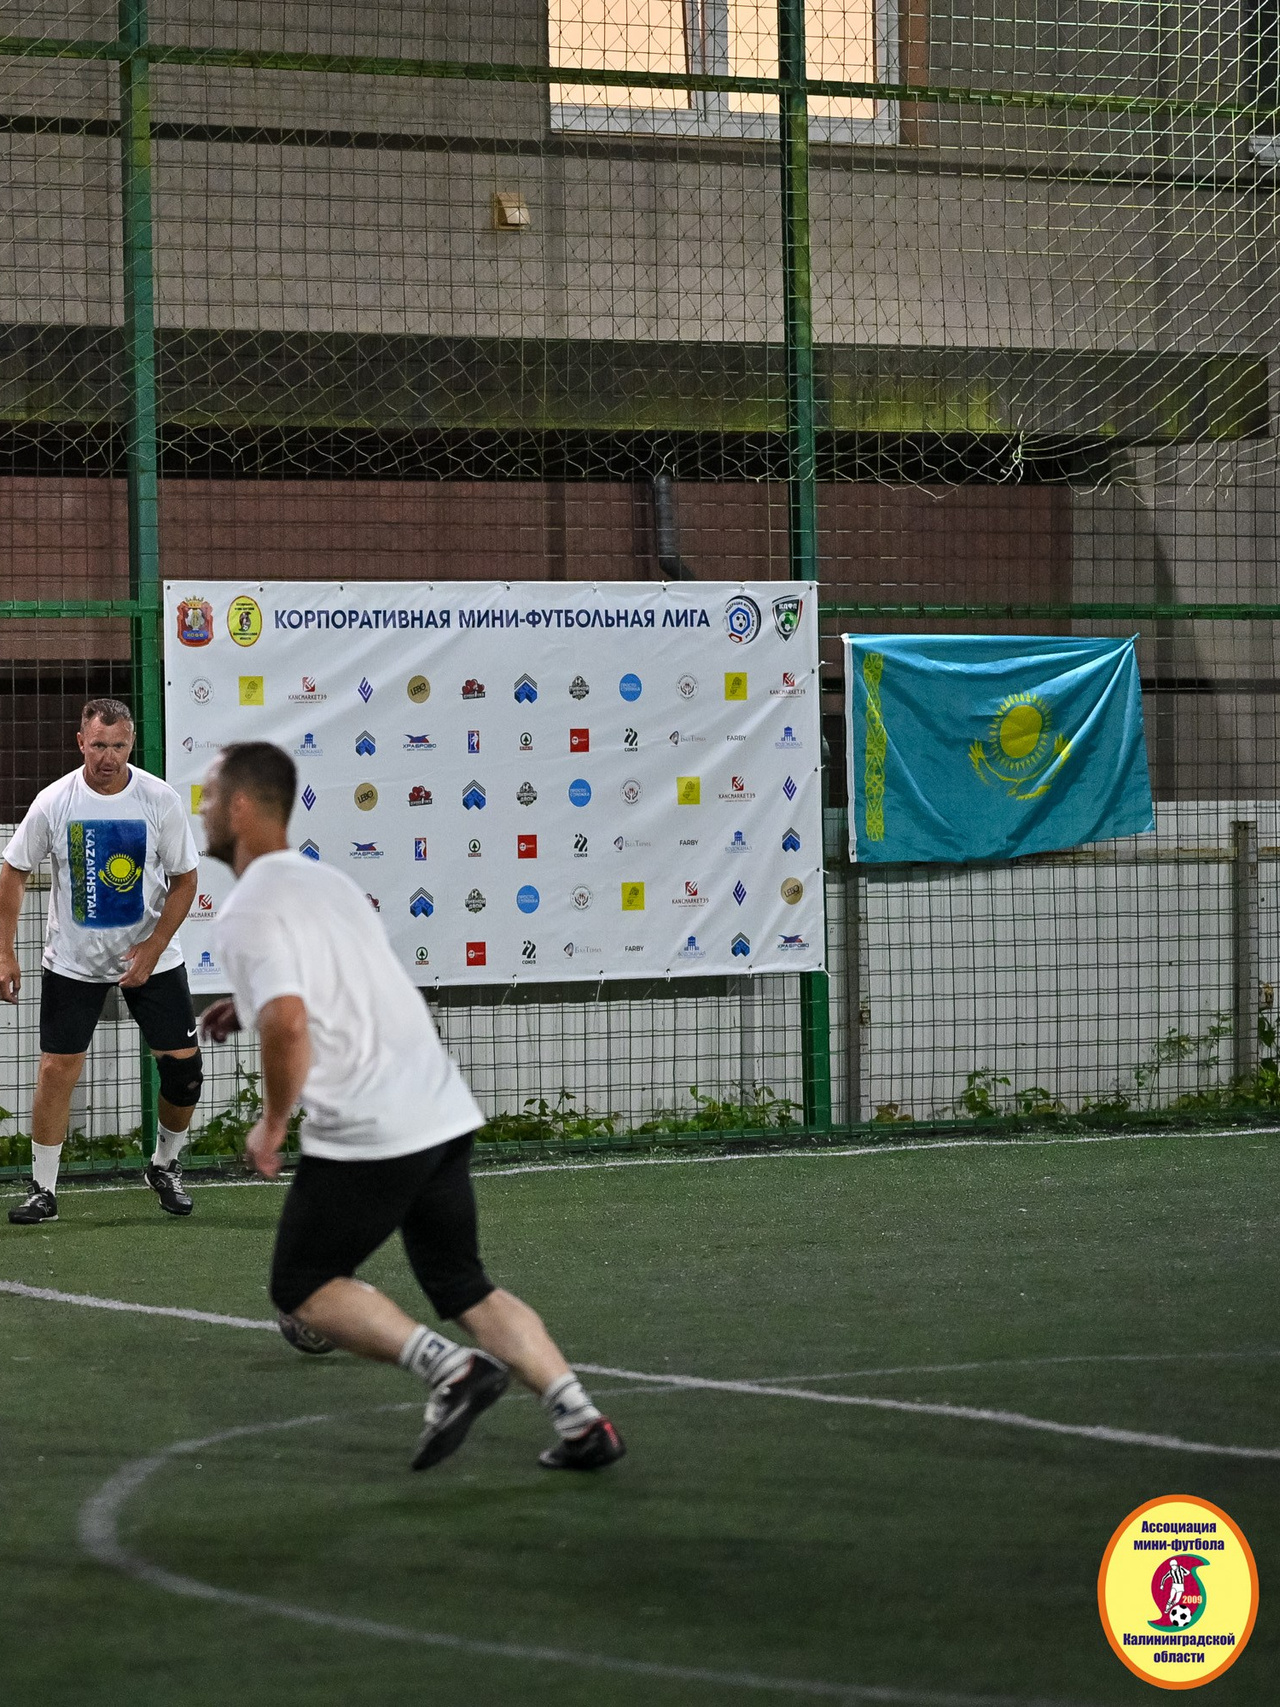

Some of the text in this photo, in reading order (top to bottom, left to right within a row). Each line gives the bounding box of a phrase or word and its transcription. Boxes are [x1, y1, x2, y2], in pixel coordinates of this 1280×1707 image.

[275, 608, 710, 630] КОРПОРАТИВНАЯ МИНИ-ФУТБОЛЬНАЯ ЛИГА
[85, 828, 97, 919] KAZAKHSTAN
